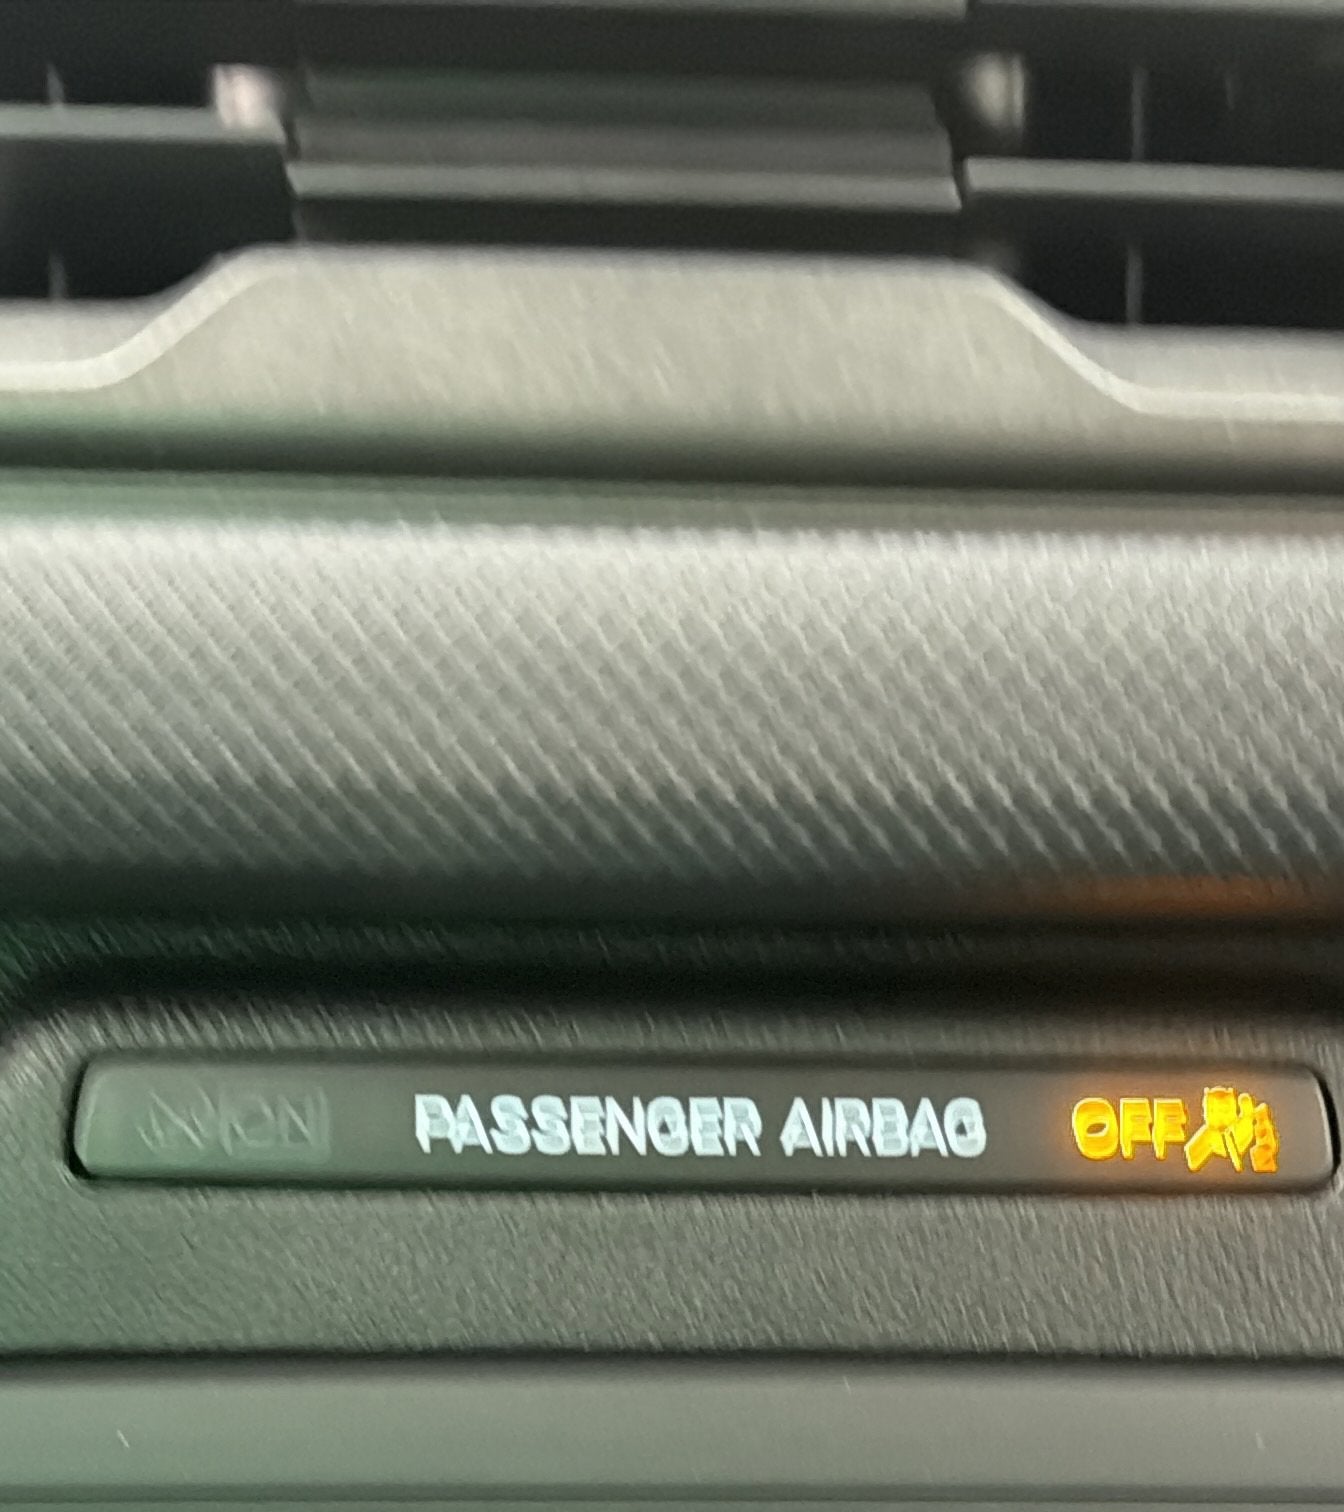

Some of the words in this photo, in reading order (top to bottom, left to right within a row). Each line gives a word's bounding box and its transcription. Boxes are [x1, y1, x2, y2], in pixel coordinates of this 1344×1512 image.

[414, 1093, 762, 1157] PASSENGER
[780, 1095, 988, 1158] AIRBAG
[1071, 1097, 1189, 1160] OFF
